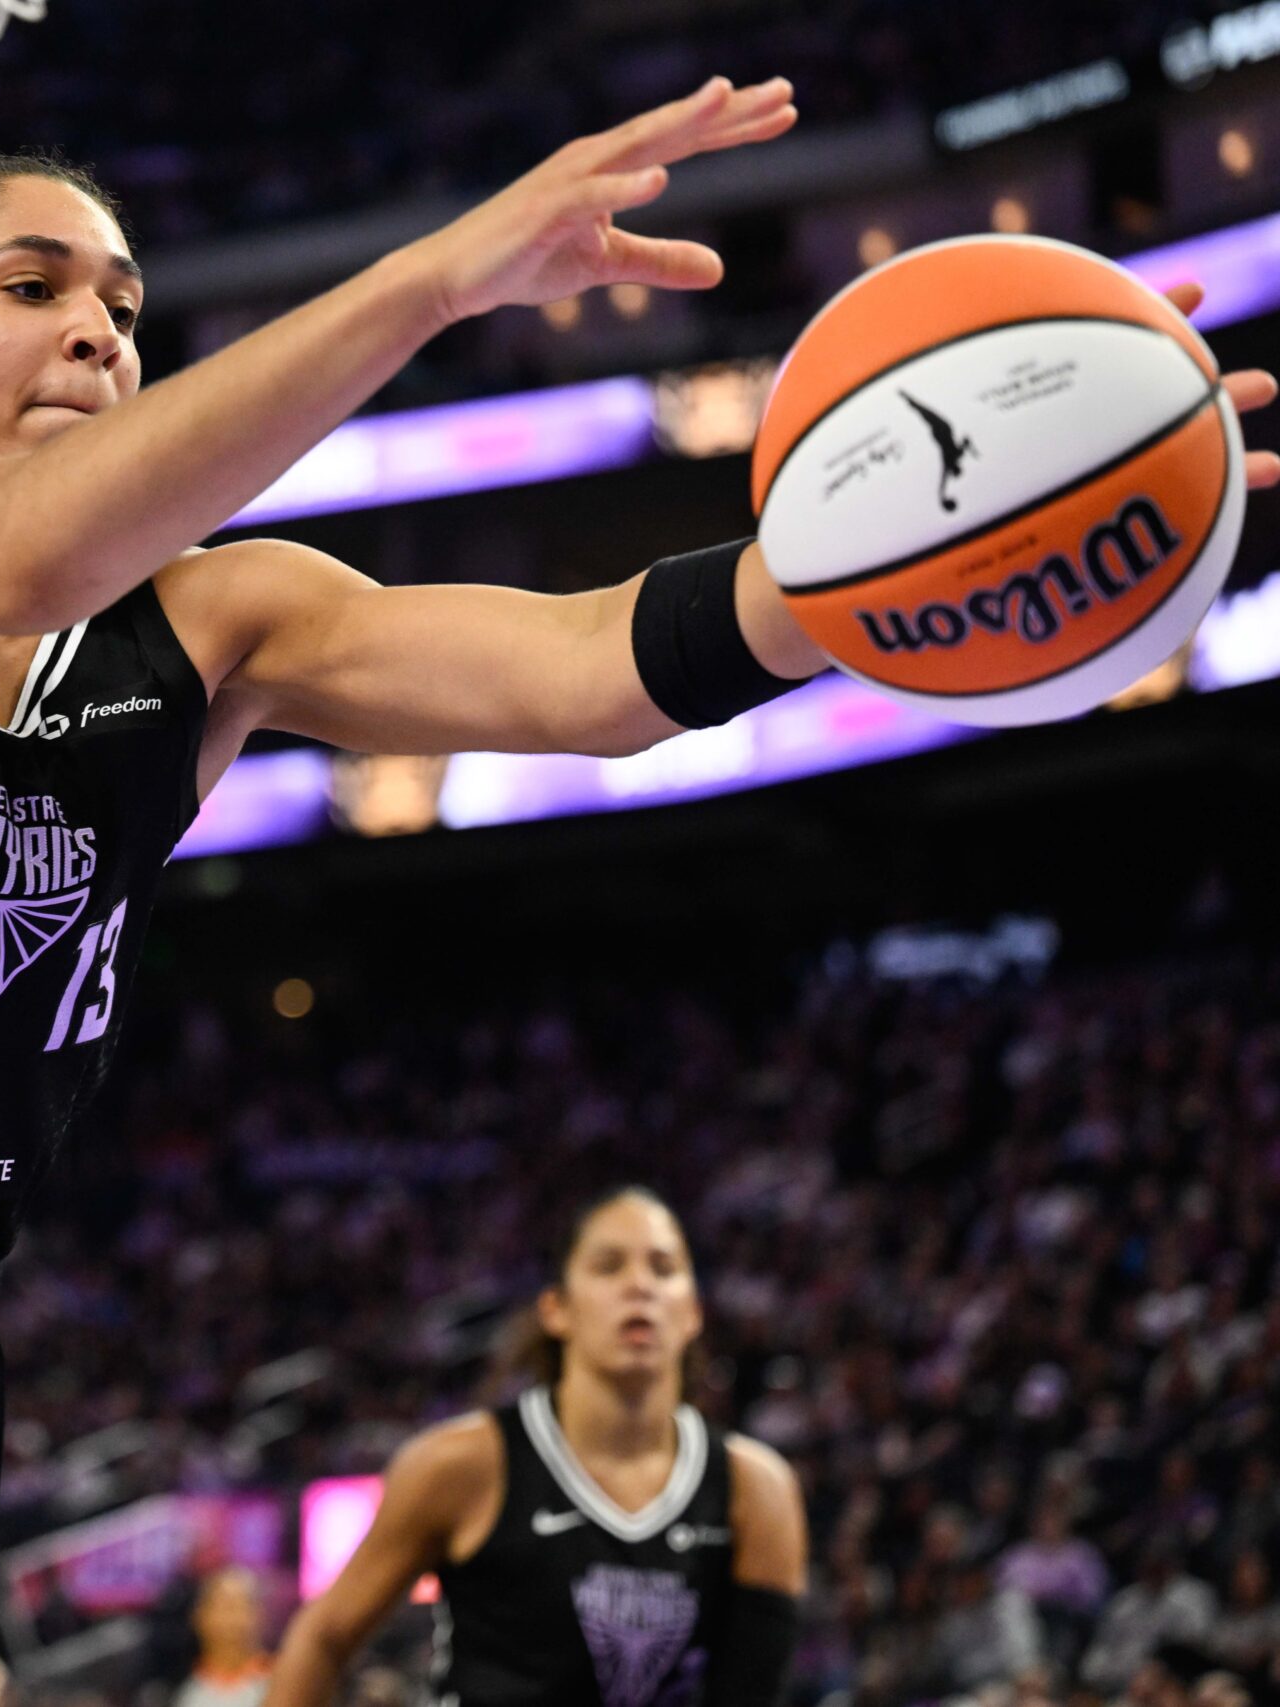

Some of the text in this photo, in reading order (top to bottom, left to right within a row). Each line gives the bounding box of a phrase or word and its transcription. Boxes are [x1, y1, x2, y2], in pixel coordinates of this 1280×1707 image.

[852, 494, 1182, 655] Wilson
[80, 696, 161, 728] freedom
[43, 896, 128, 1052] 13
